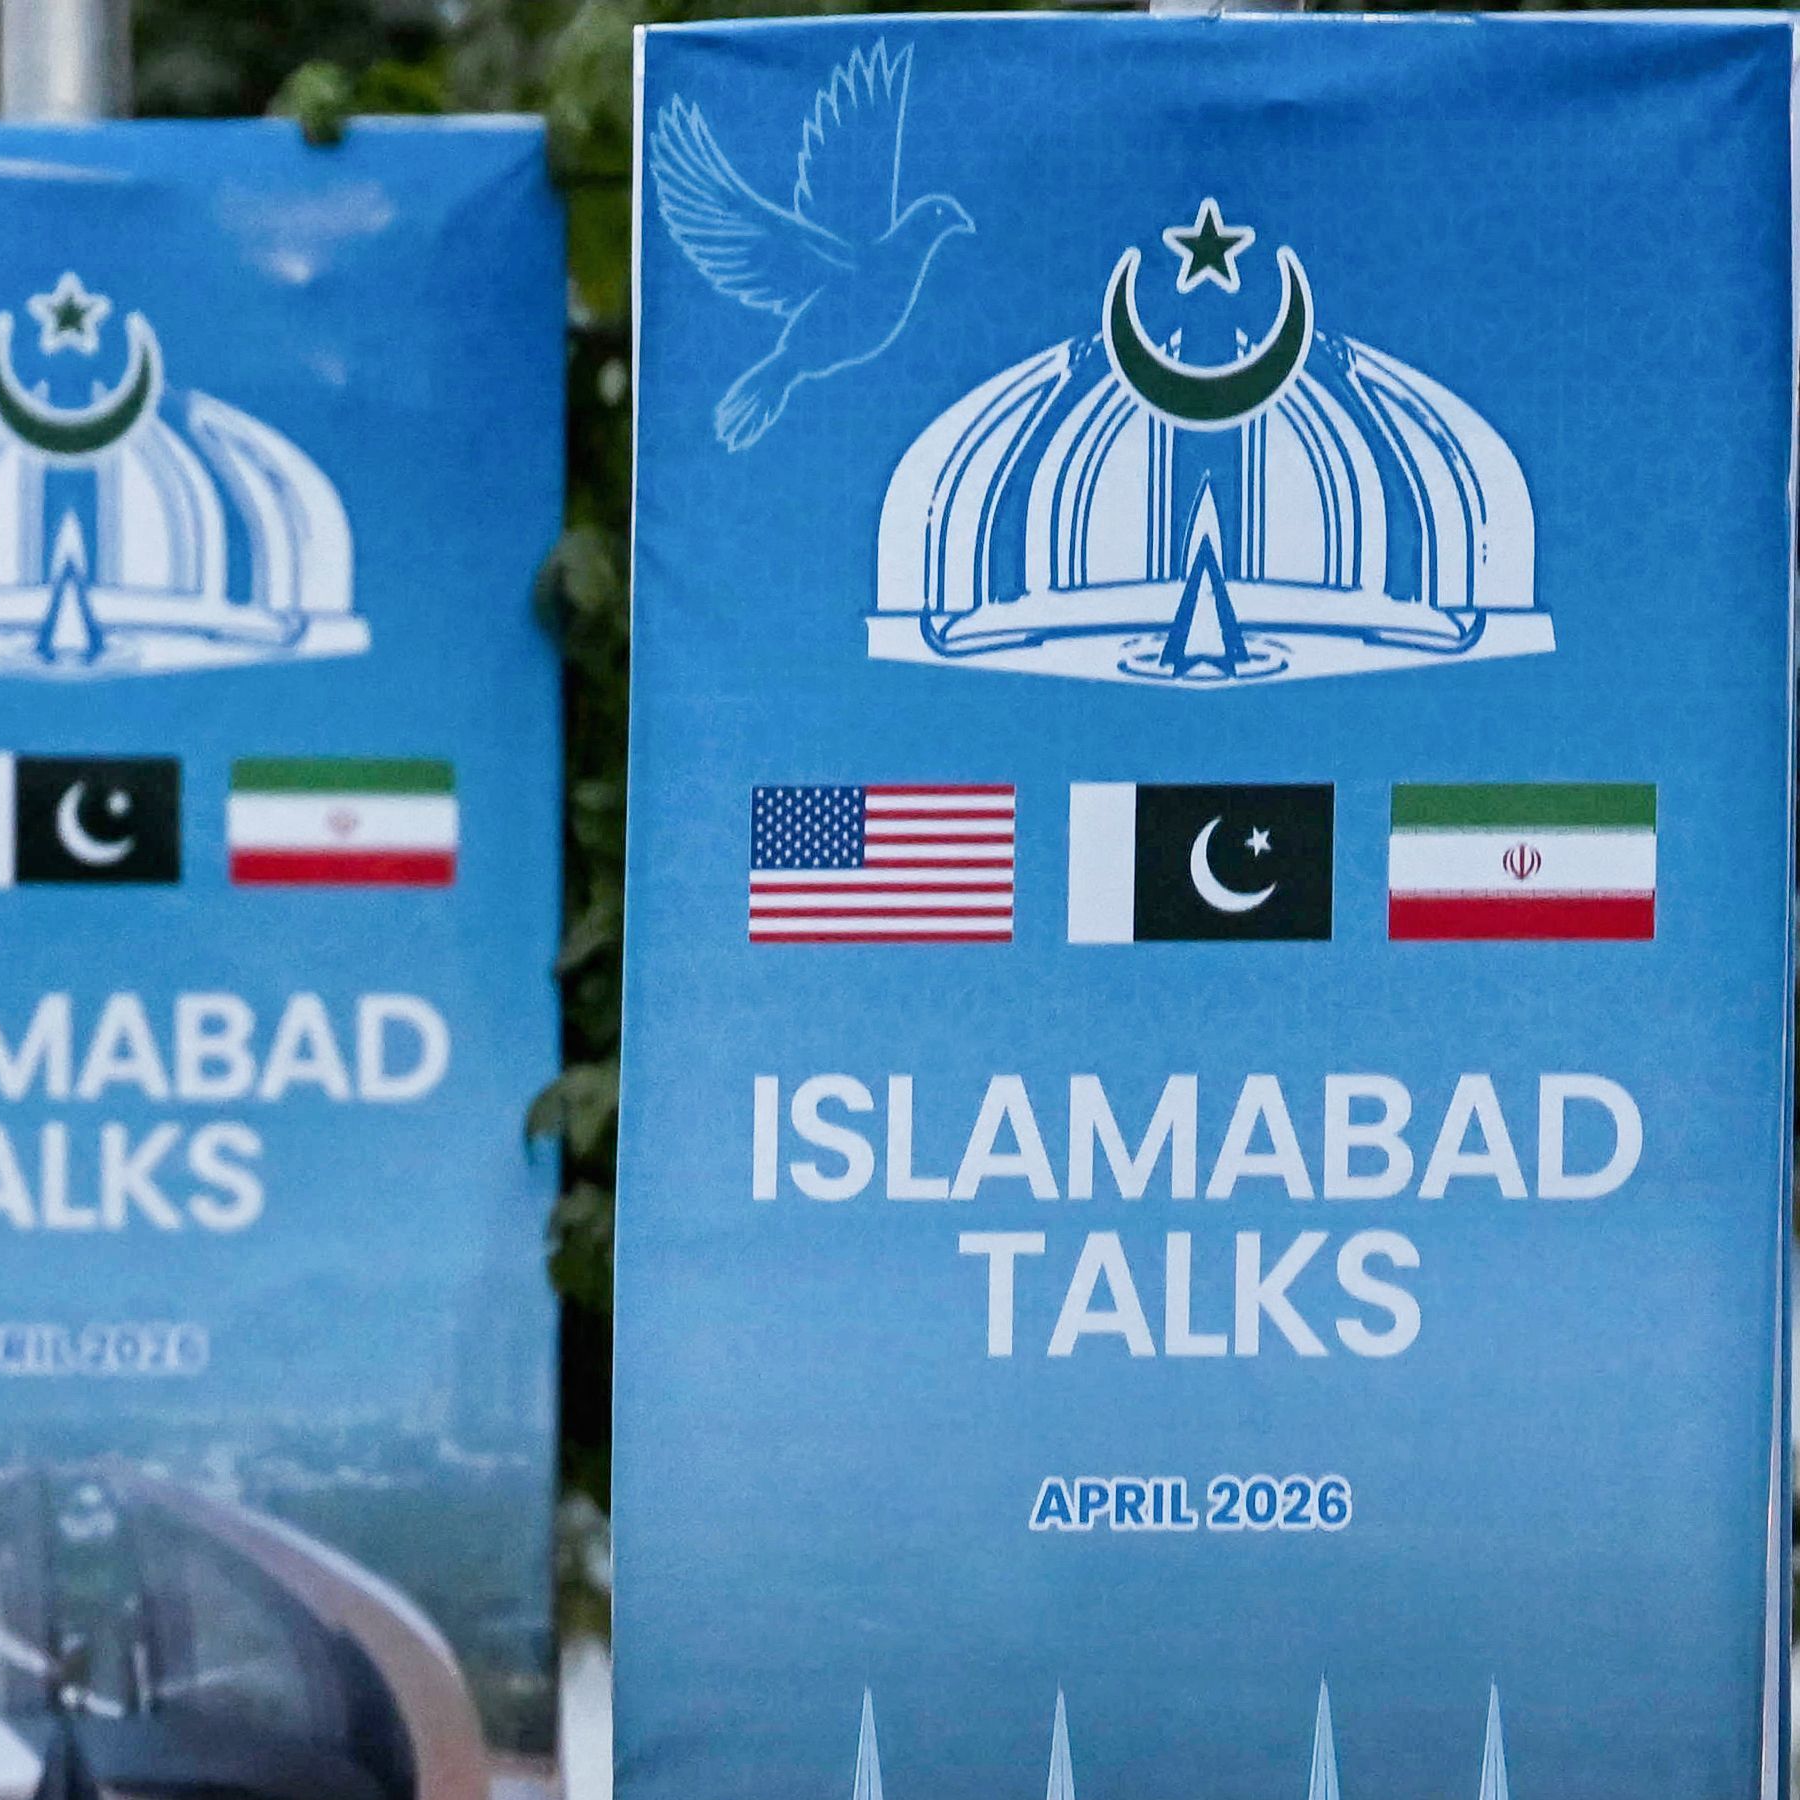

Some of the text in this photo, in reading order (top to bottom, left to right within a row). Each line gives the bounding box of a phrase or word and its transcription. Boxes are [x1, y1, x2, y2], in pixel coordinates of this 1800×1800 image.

[751, 1073, 1645, 1203] ISLAMABAD
[957, 1229, 1422, 1359] TALKS
[1028, 1474, 1354, 1532] APRIL 2026
